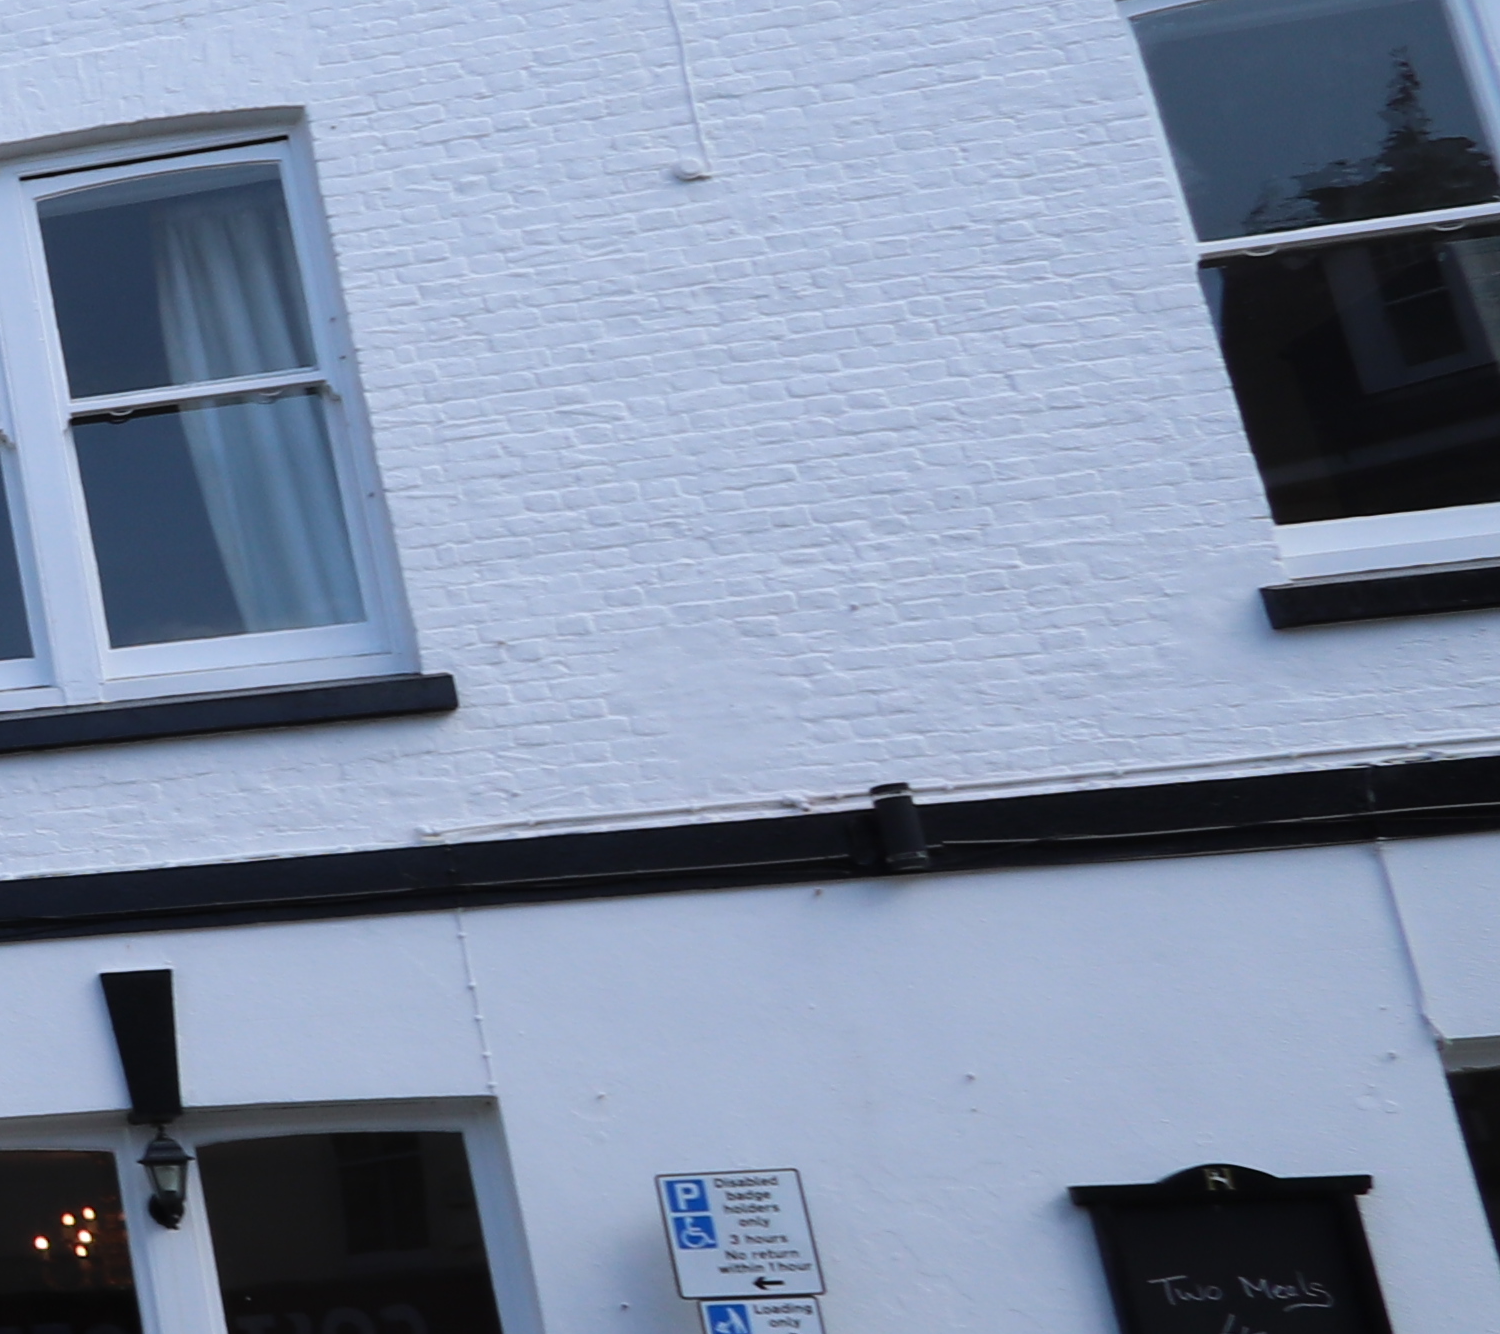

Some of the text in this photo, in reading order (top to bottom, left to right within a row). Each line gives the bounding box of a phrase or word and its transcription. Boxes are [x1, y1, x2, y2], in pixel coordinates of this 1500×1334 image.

[713, 1177, 779, 1189] Disabled
[674, 1182, 700, 1210] P
[724, 1190, 772, 1202] badge
[723, 1203, 781, 1214] holders
[738, 1217, 771, 1228] only
[729, 1233, 789, 1245] 3 hours
[724, 1249, 800, 1260] No return
[718, 1263, 813, 1274] within 1 hour
[1148, 1271, 1334, 1311] Two Meals
[753, 1303, 814, 1315] Loading
[768, 1317, 801, 1328] only
